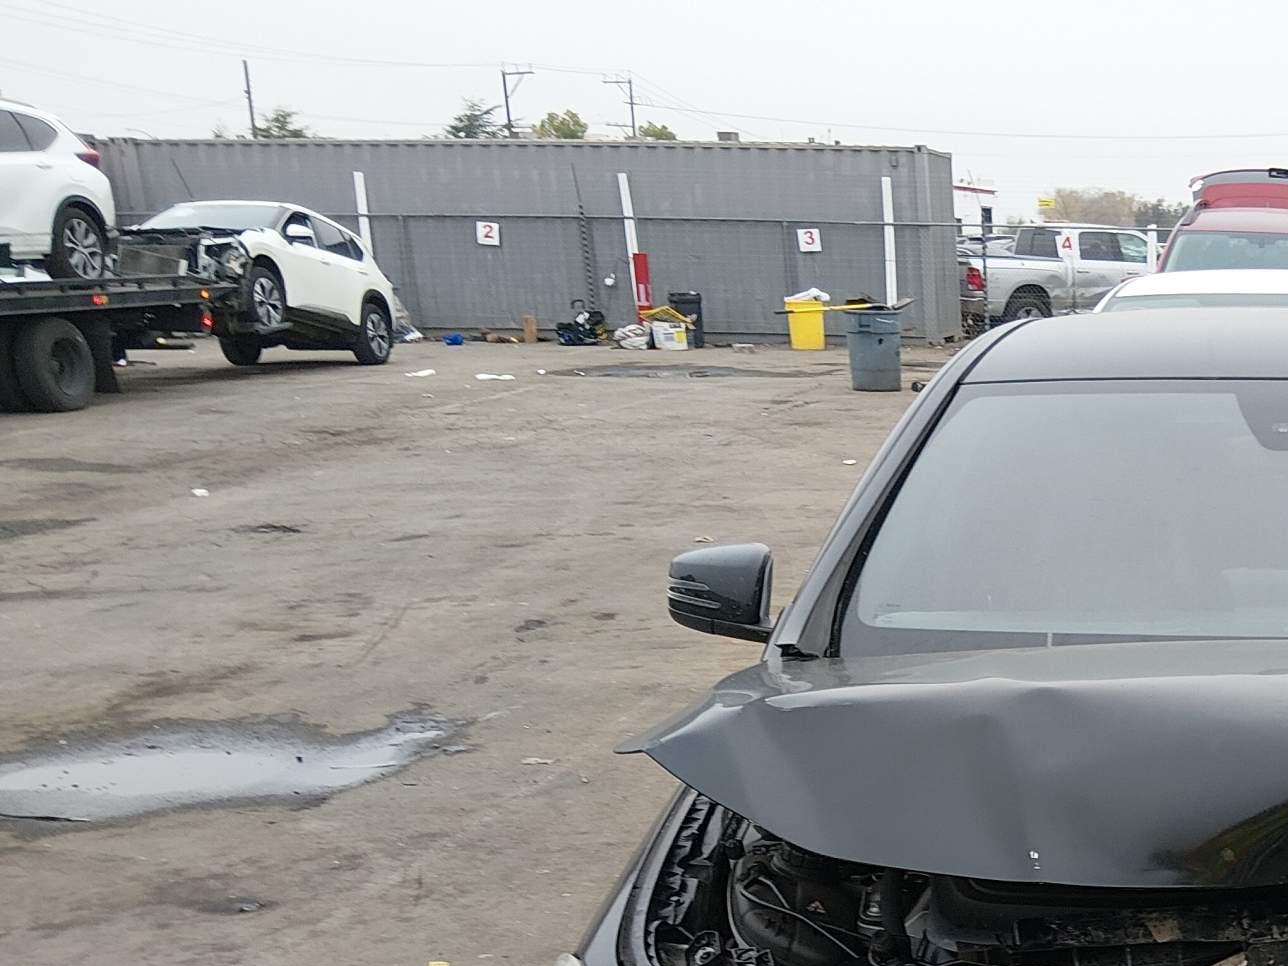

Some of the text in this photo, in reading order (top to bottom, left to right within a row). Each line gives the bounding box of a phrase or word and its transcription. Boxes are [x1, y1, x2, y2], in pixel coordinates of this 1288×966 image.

[483, 224, 494, 239] 2
[804, 230, 815, 245] 3
[1062, 236, 1072, 250] 4
